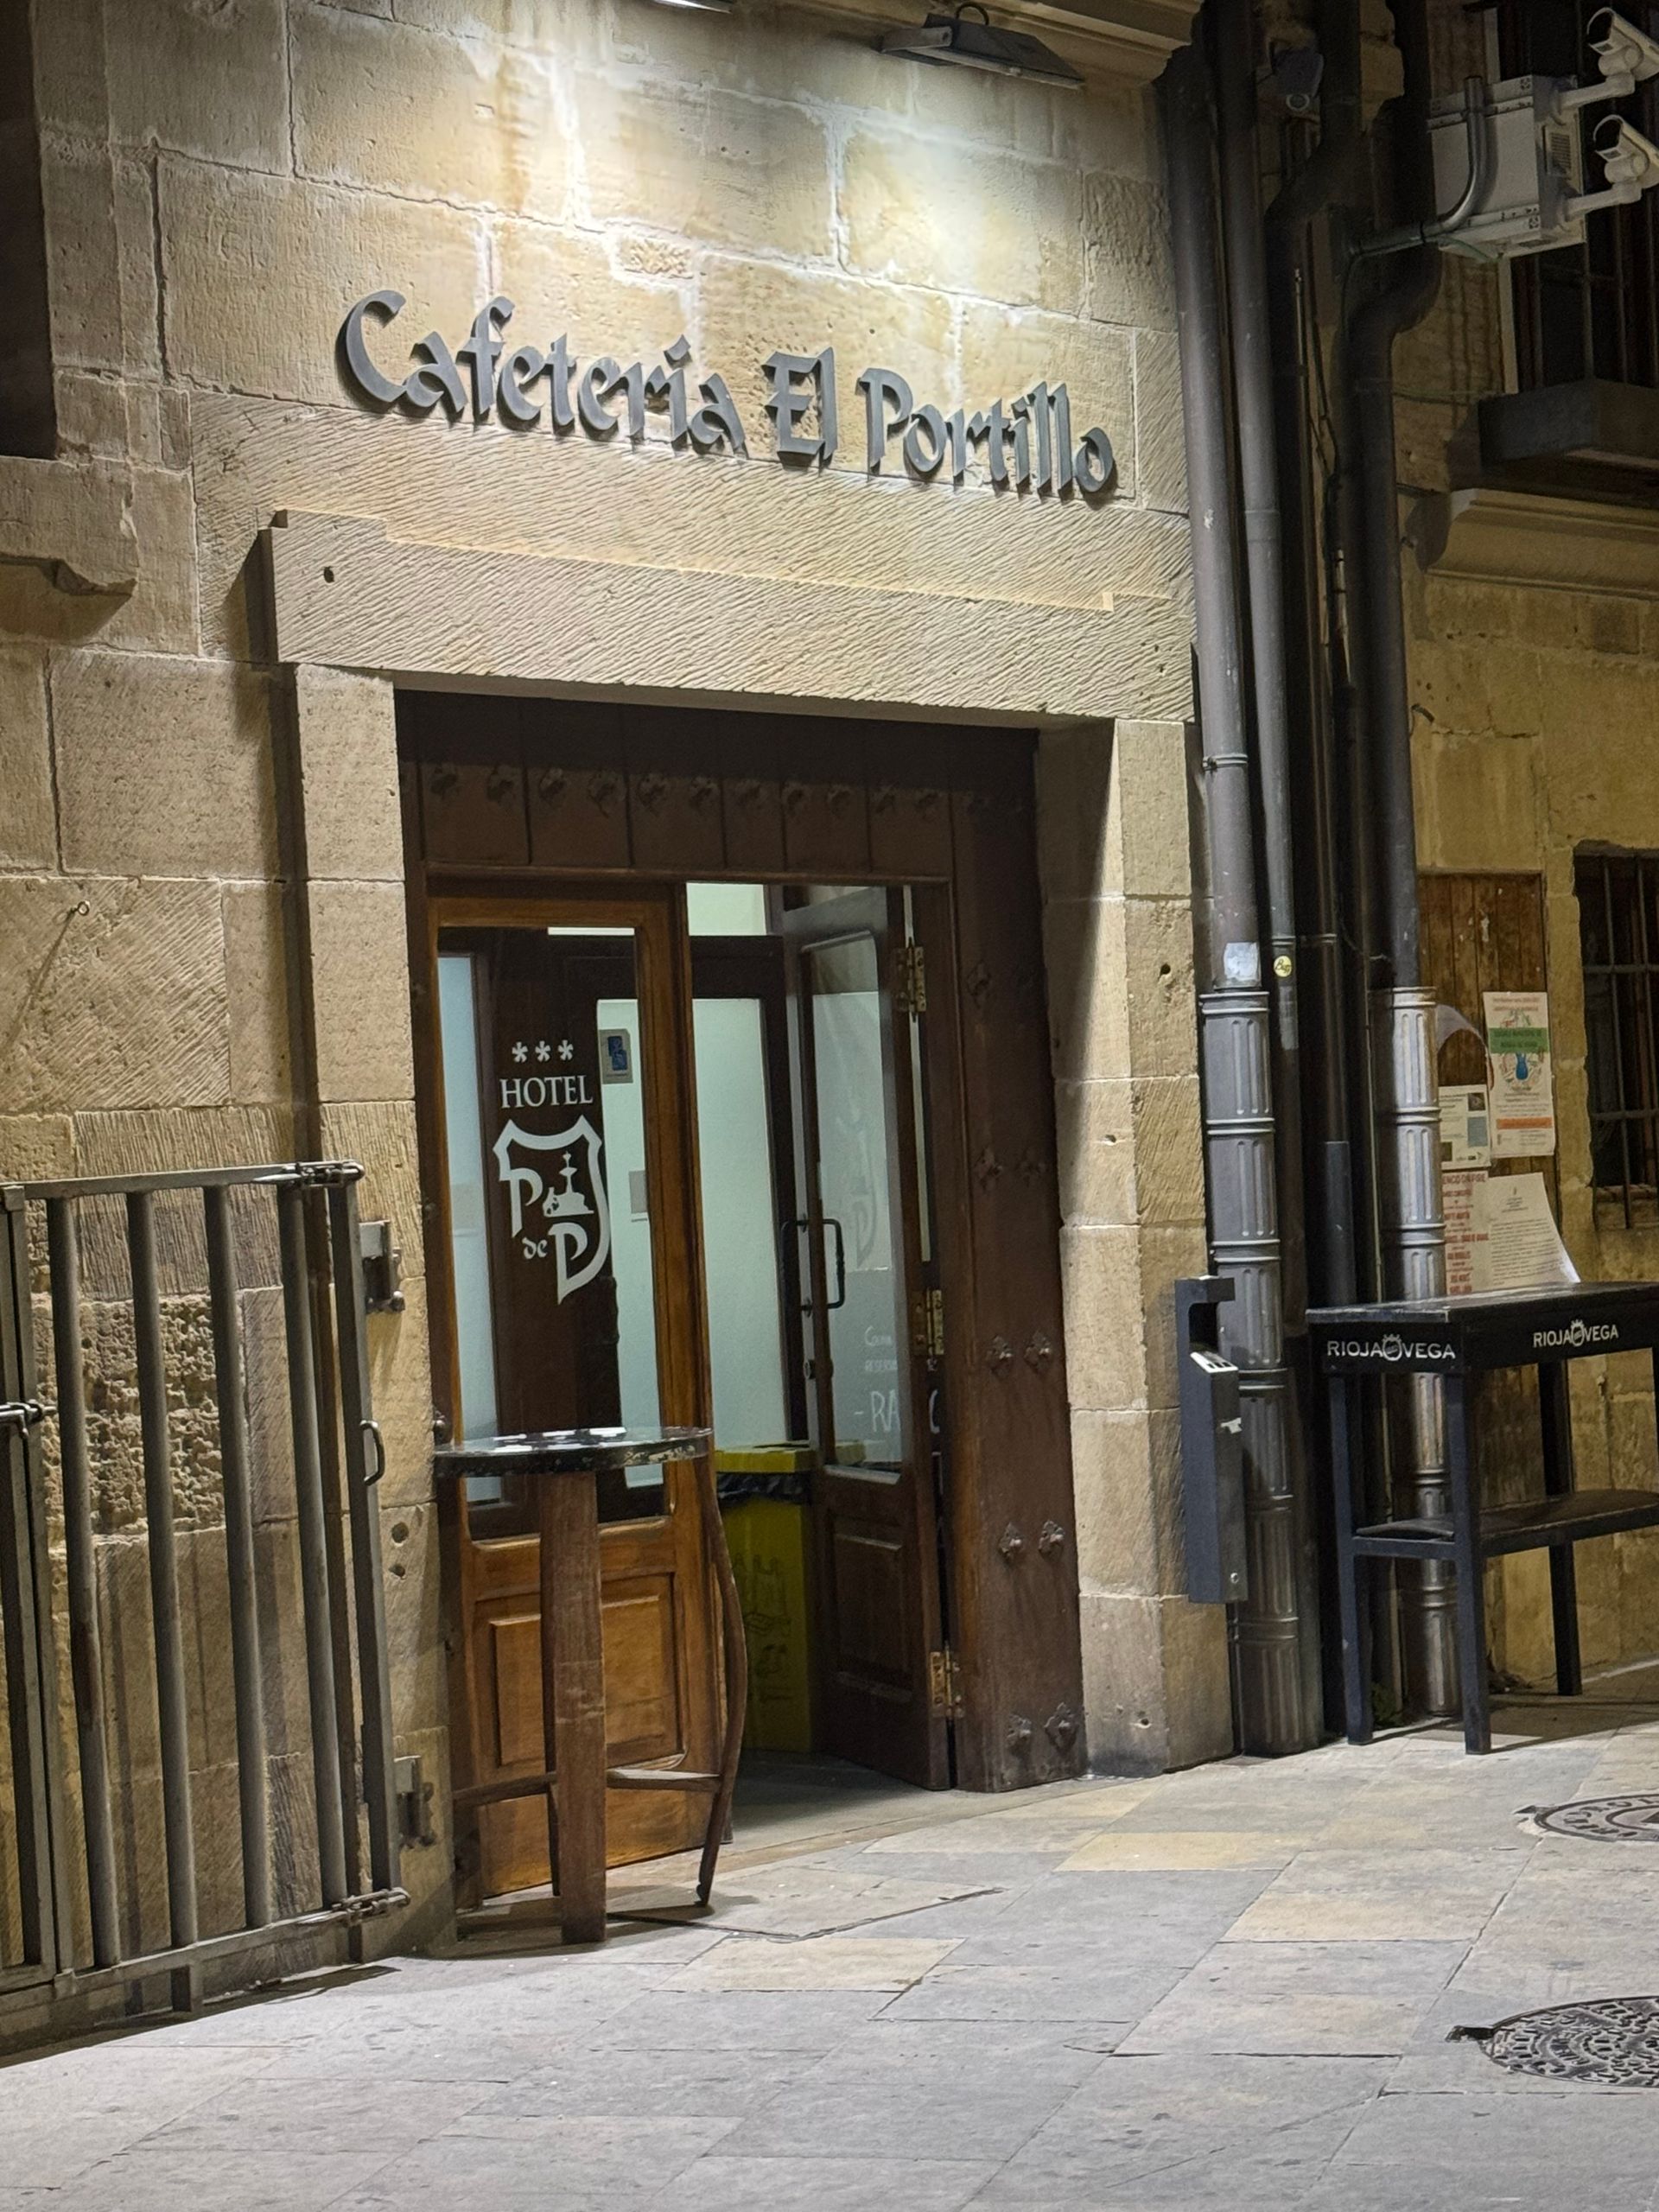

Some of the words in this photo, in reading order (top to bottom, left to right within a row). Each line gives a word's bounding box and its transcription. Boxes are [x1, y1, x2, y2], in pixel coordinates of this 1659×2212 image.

[760, 346, 837, 465] El
[858, 366, 1116, 496] Portillo
[499, 1074, 594, 1109] HOTEL
[500, 1166, 543, 1238] P
[522, 1236, 549, 1260] de
[1326, 1340, 1383, 1357] RIOJA
[1402, 1342, 1456, 1359] VEGA
[1533, 1328, 1573, 1348] RIOJA
[1584, 1324, 1619, 1342] VEGA
